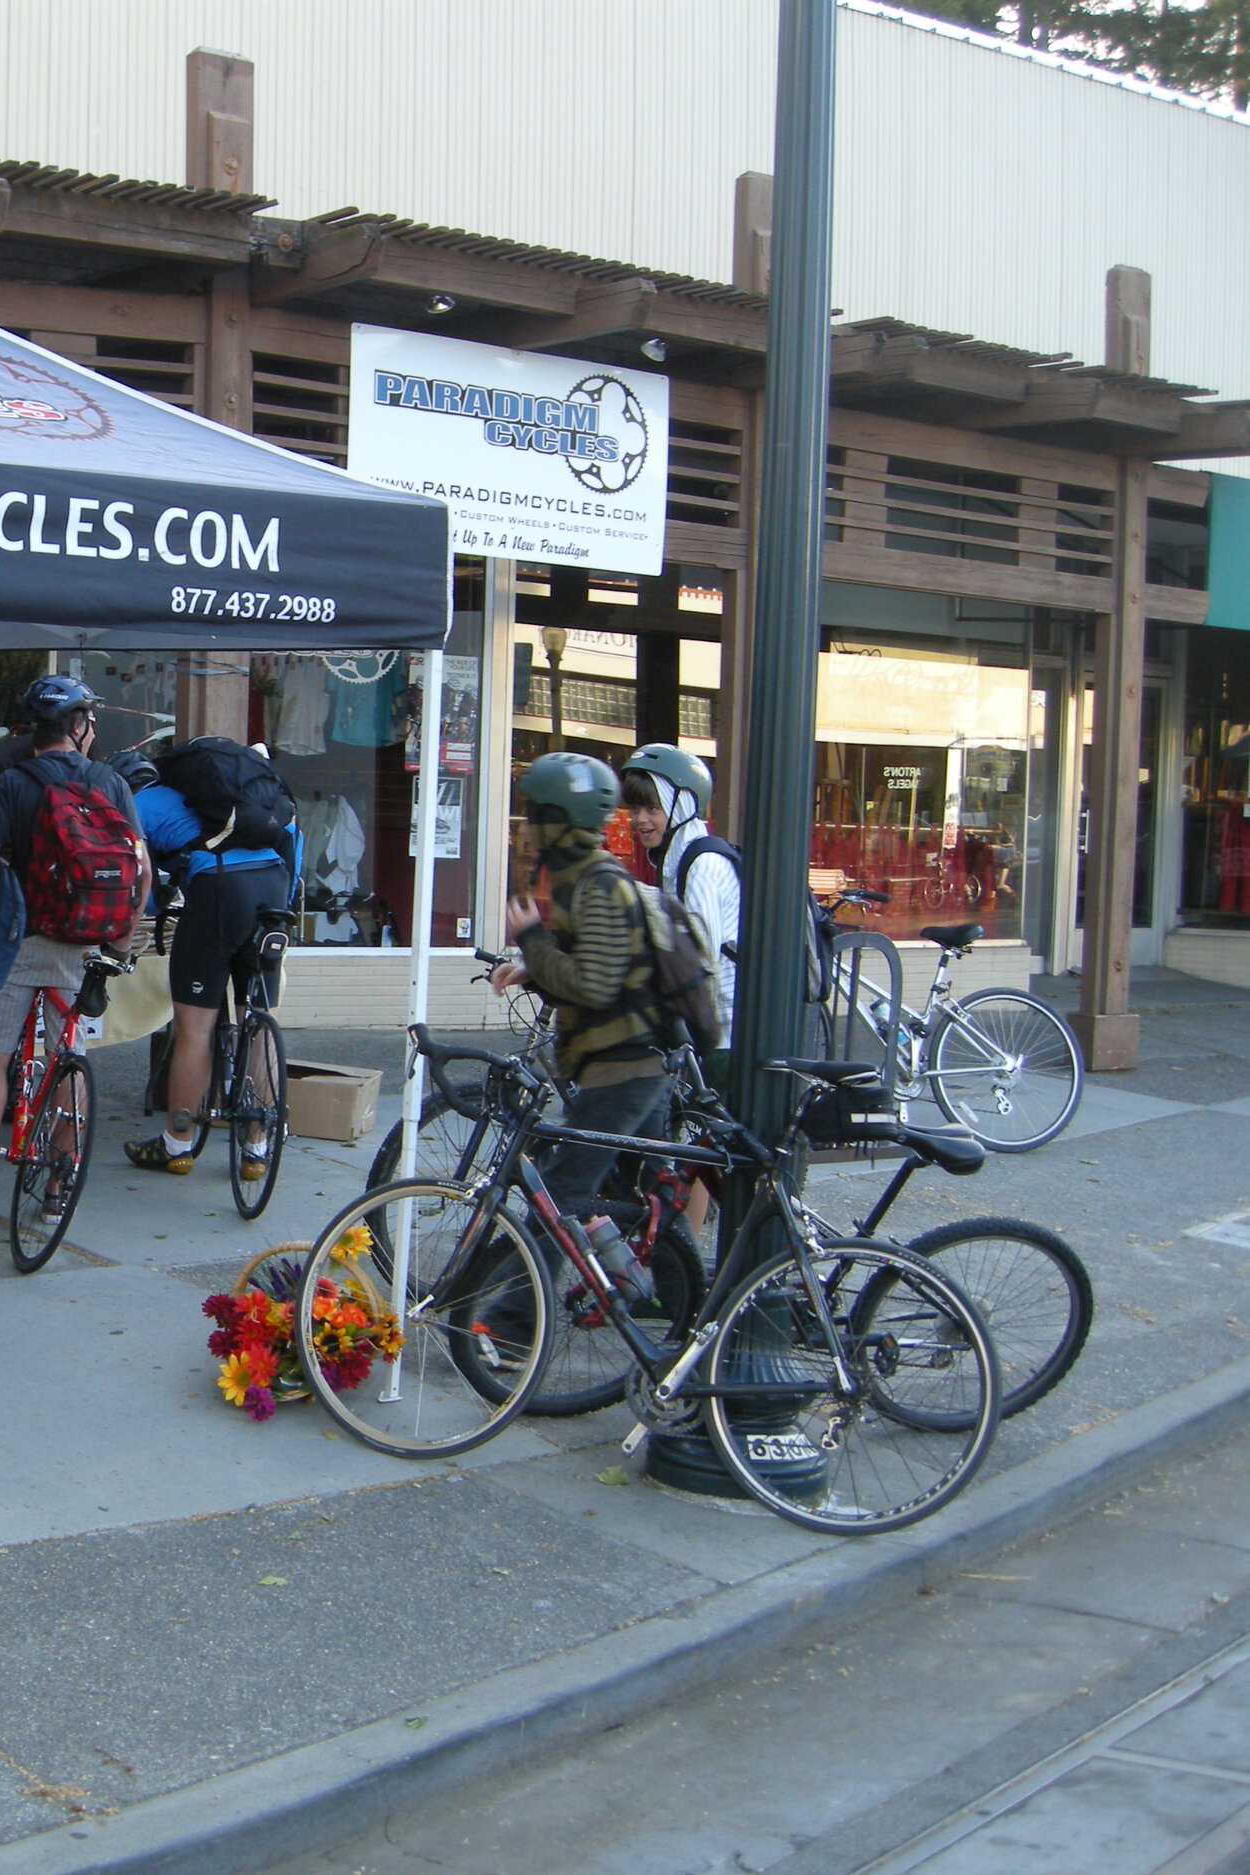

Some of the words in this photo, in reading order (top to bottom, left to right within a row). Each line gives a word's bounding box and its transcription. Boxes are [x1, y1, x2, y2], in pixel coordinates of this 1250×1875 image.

[374, 369, 599, 434] PARADIGM
[484, 419, 619, 462] CYCLES
[462, 530, 478, 547] Up
[498, 534, 507, 548] A
[512, 536, 535, 551] New
[540, 539, 590, 560] Paradigm
[171, 587, 336, 622] 877.437.2988
